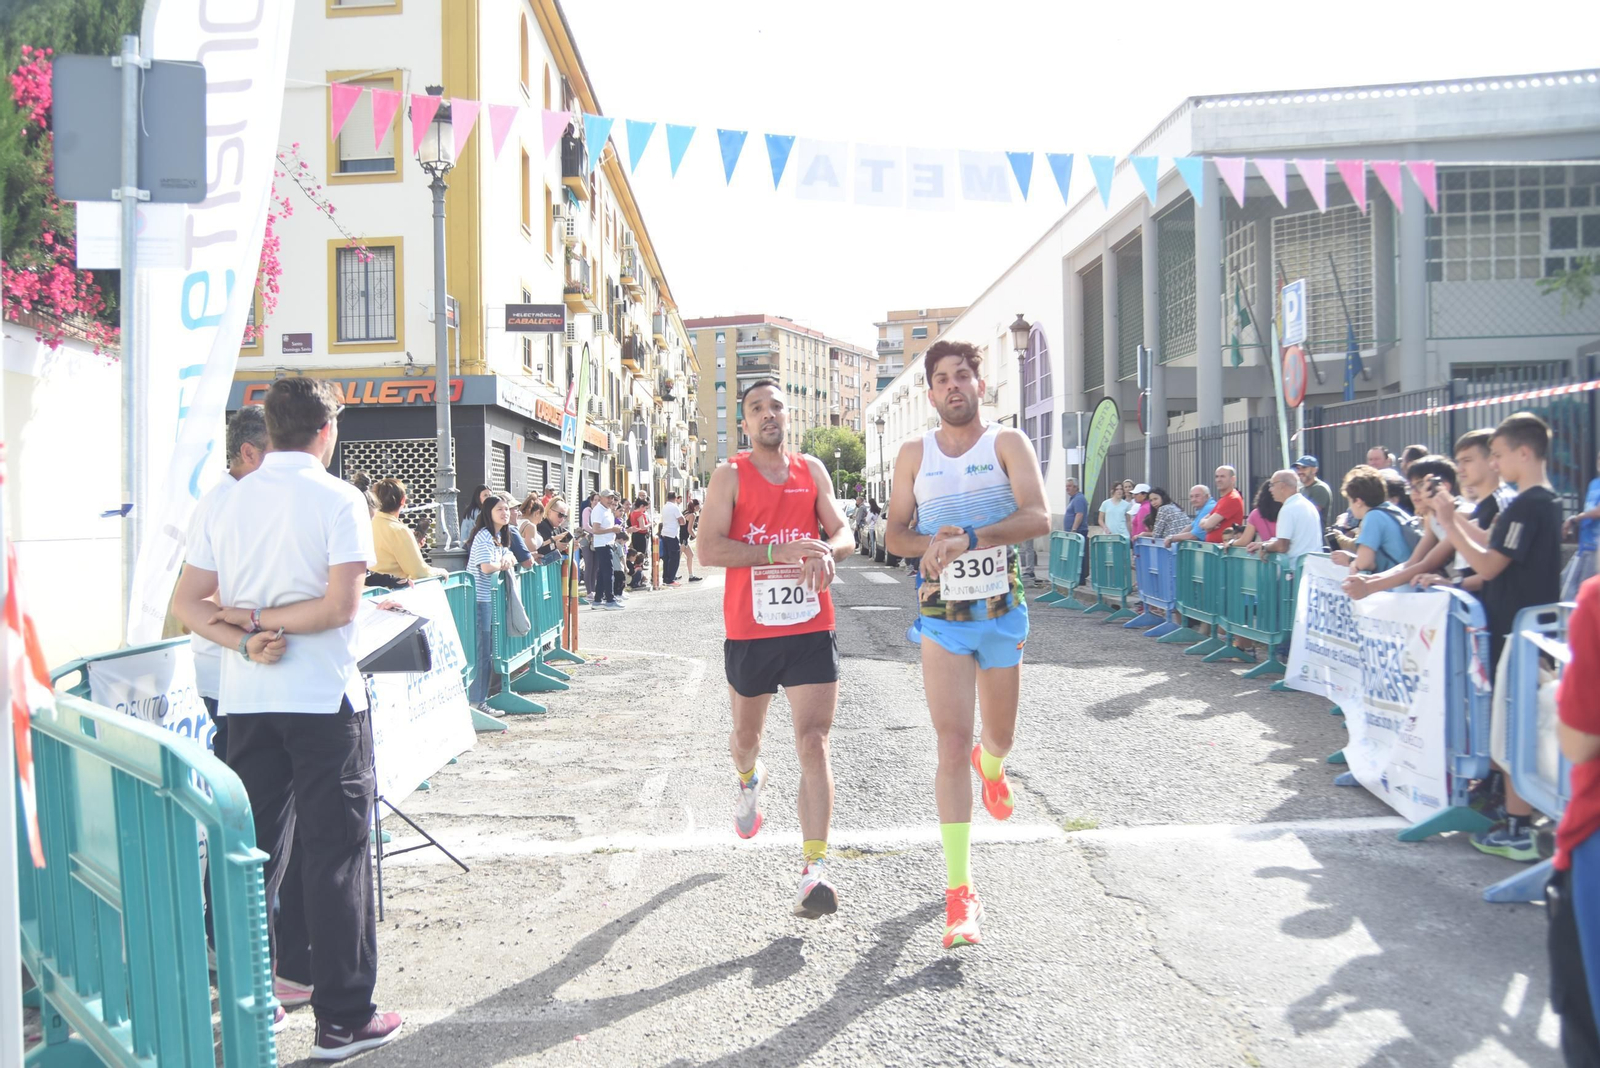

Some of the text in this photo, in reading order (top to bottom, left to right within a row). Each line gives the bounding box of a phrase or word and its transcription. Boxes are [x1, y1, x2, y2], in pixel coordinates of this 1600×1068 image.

[1286, 291, 1298, 338] P
[953, 557, 994, 578] 330
[768, 587, 804, 605] 120
